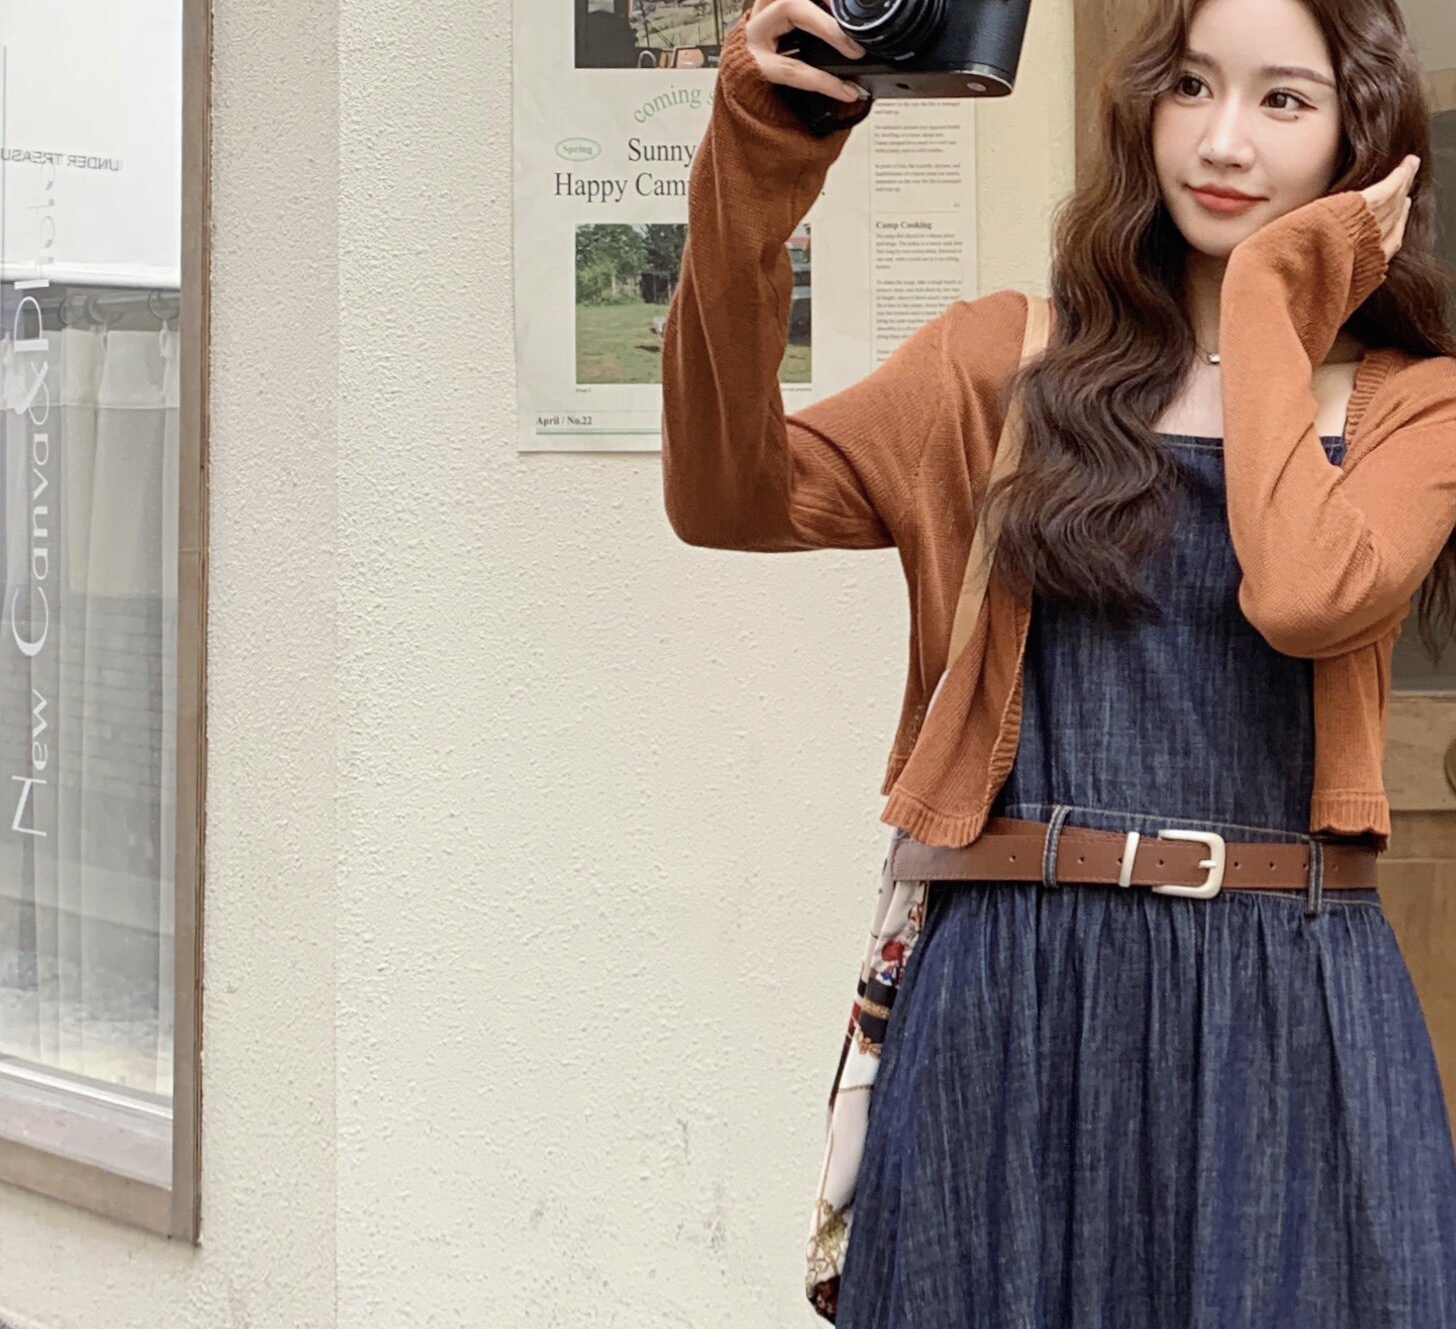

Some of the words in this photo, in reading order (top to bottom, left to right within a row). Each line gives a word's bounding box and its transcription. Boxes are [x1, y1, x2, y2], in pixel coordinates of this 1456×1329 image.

[633, 84, 701, 124] coming
[562, 142, 593, 156] Spring
[627, 137, 697, 168] Sunny
[553, 172, 628, 203] Happy
[875, 221, 899, 231] Camp
[535, 415, 560, 428] April
[566, 415, 593, 426] No.22
[11, 684, 50, 838] New
